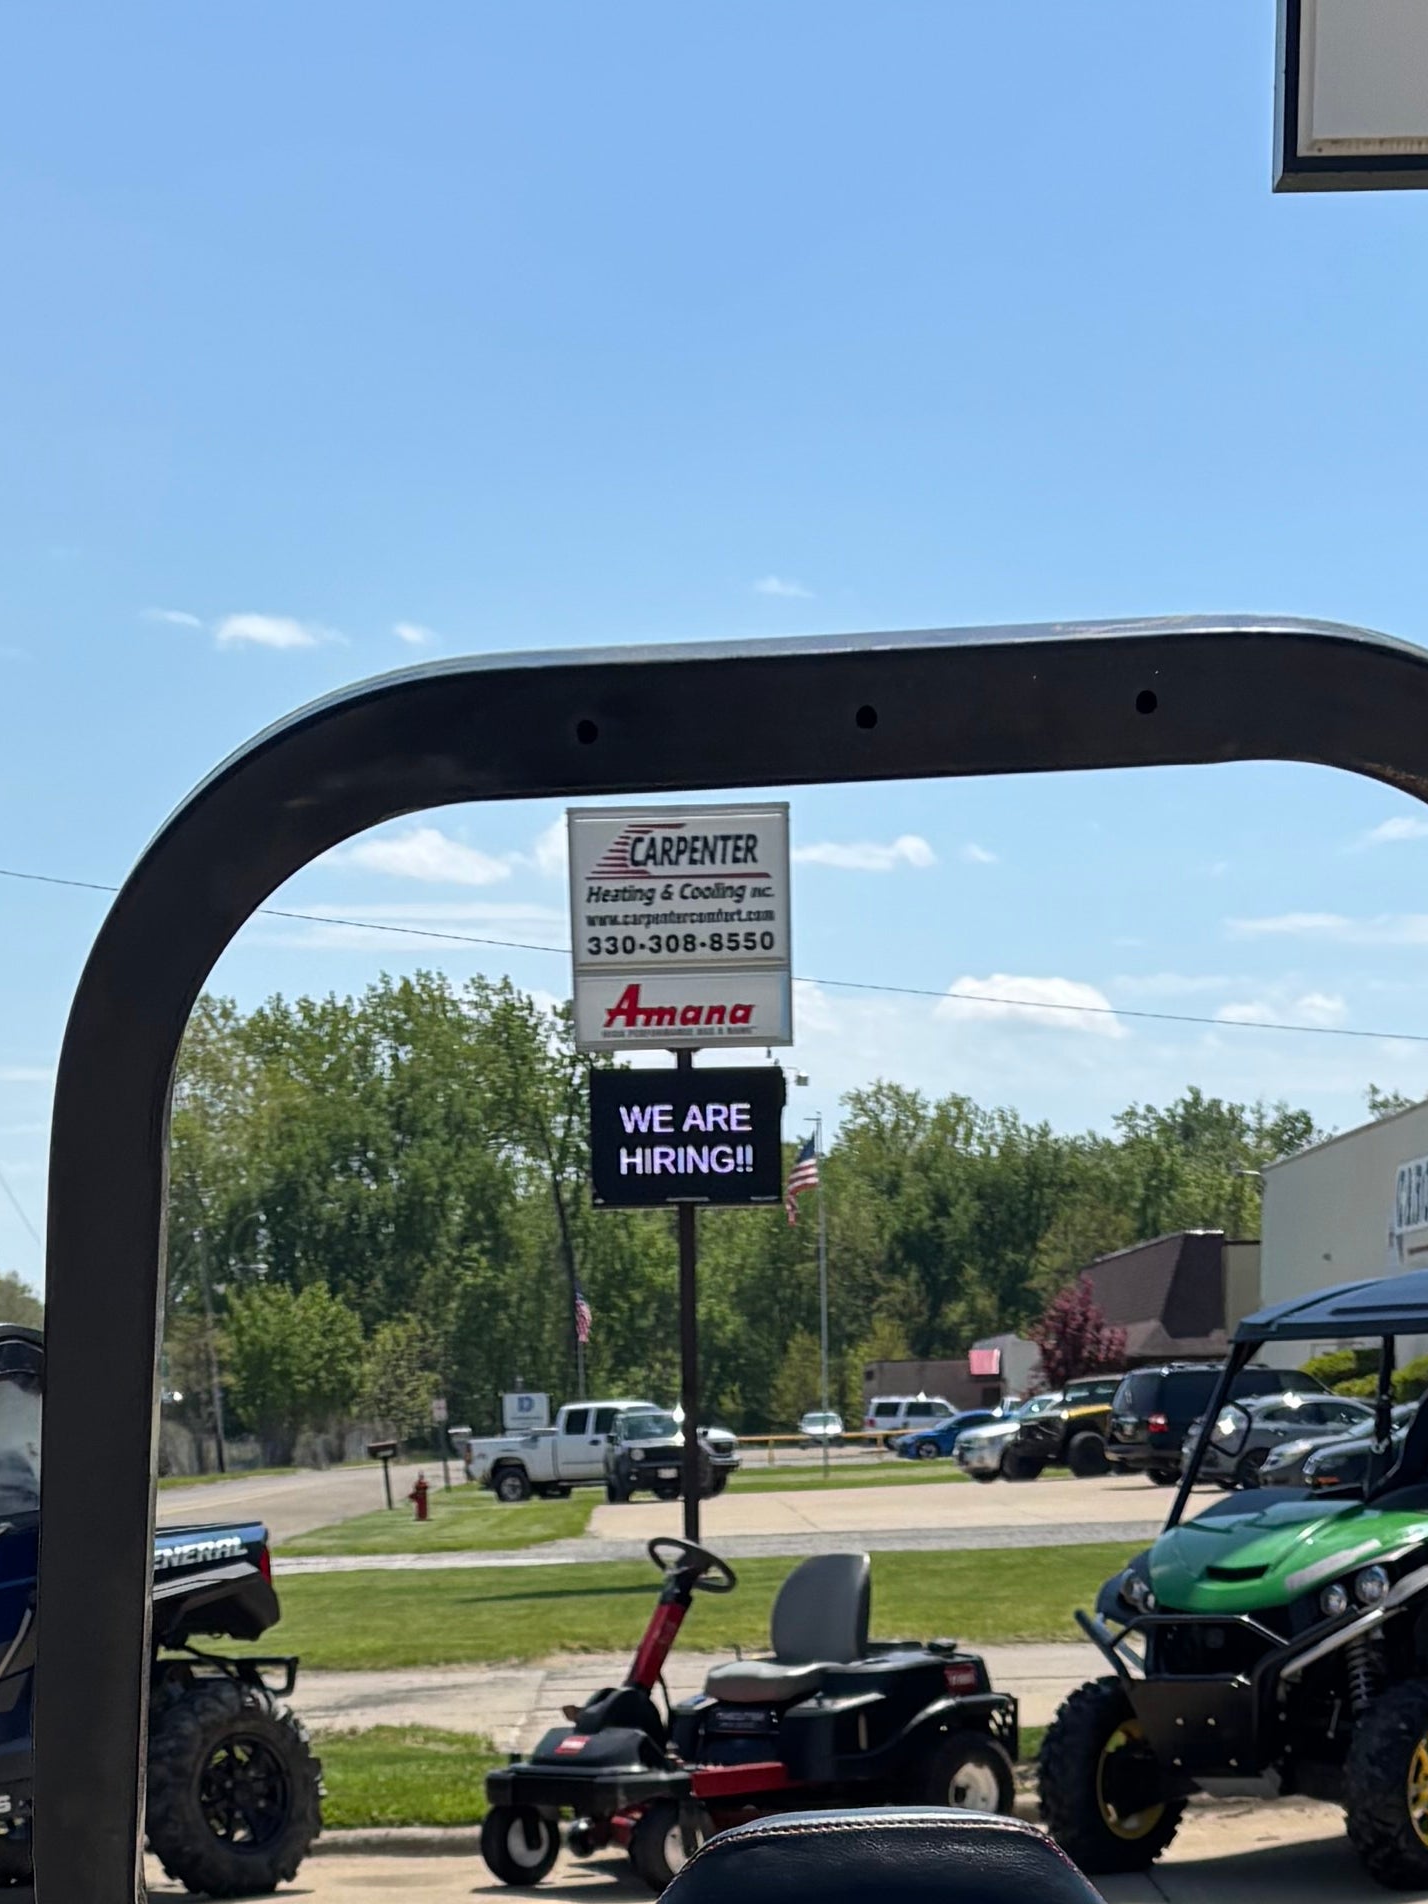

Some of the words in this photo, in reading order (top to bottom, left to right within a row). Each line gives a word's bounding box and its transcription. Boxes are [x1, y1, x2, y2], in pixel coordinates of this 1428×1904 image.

[630, 833, 758, 868] CARPENTER
[586, 885, 656, 906] Heating
[660, 884, 674, 901] &
[679, 882, 746, 903] Cooling
[603, 984, 756, 1028] Amana
[619, 1104, 674, 1134] WE
[682, 1103, 752, 1133] ARE
[619, 1144, 754, 1175] HIRING!!
